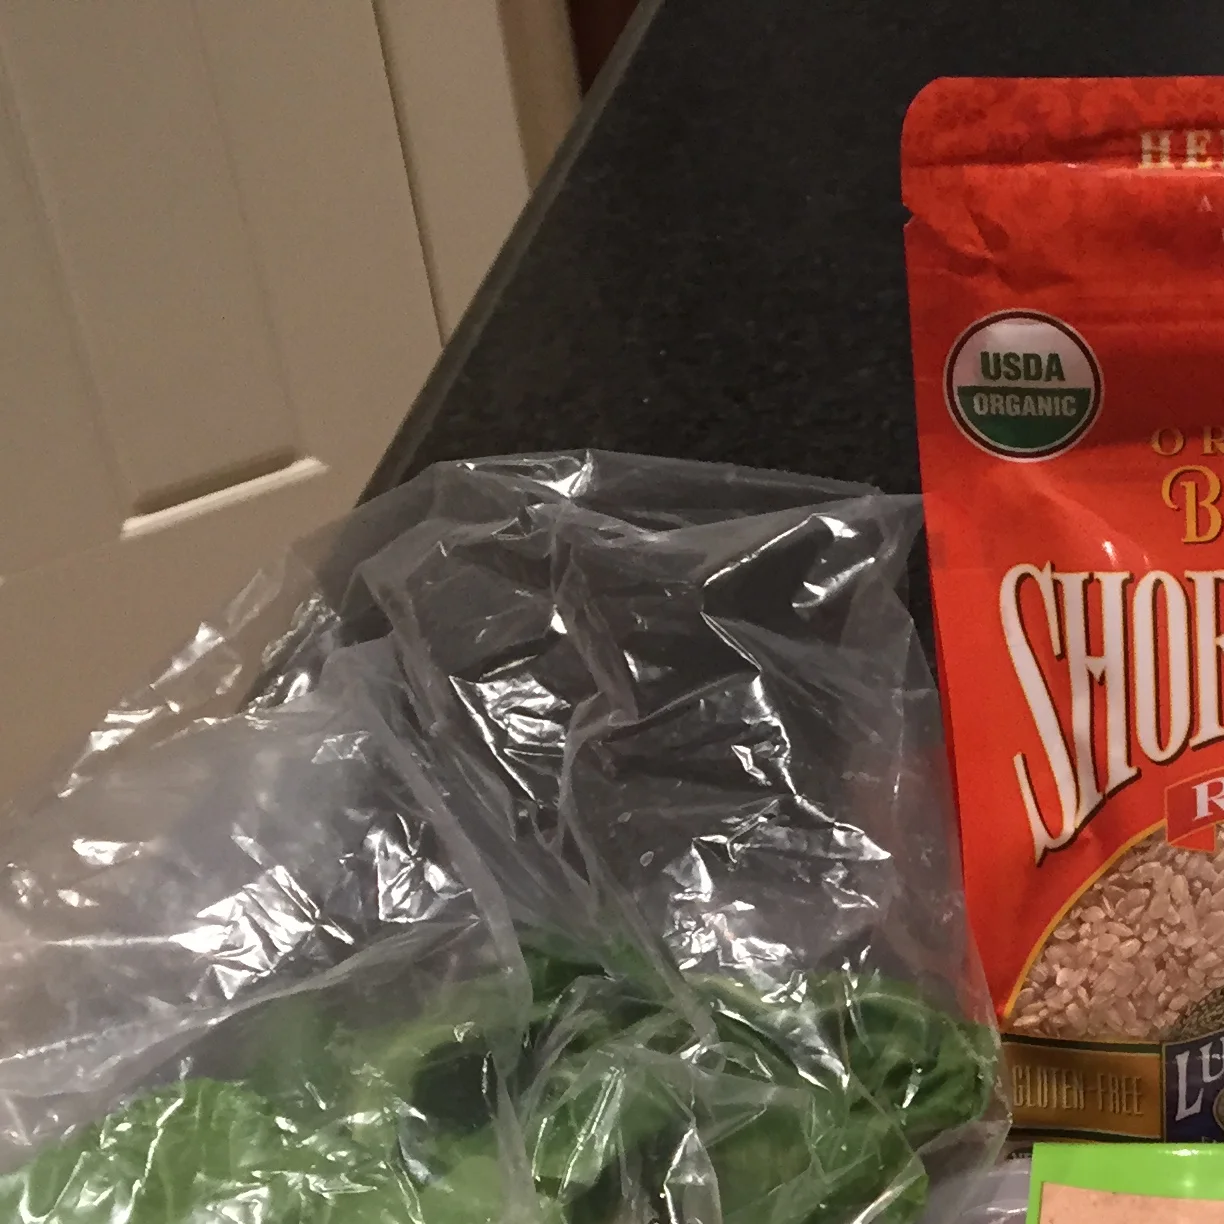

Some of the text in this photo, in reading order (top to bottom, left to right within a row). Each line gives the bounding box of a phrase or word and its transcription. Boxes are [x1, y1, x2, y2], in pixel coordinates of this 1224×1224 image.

[1198, 194, 1214, 213] A
[980, 351, 1066, 383] USDA
[972, 390, 1078, 418] ORGANIC
